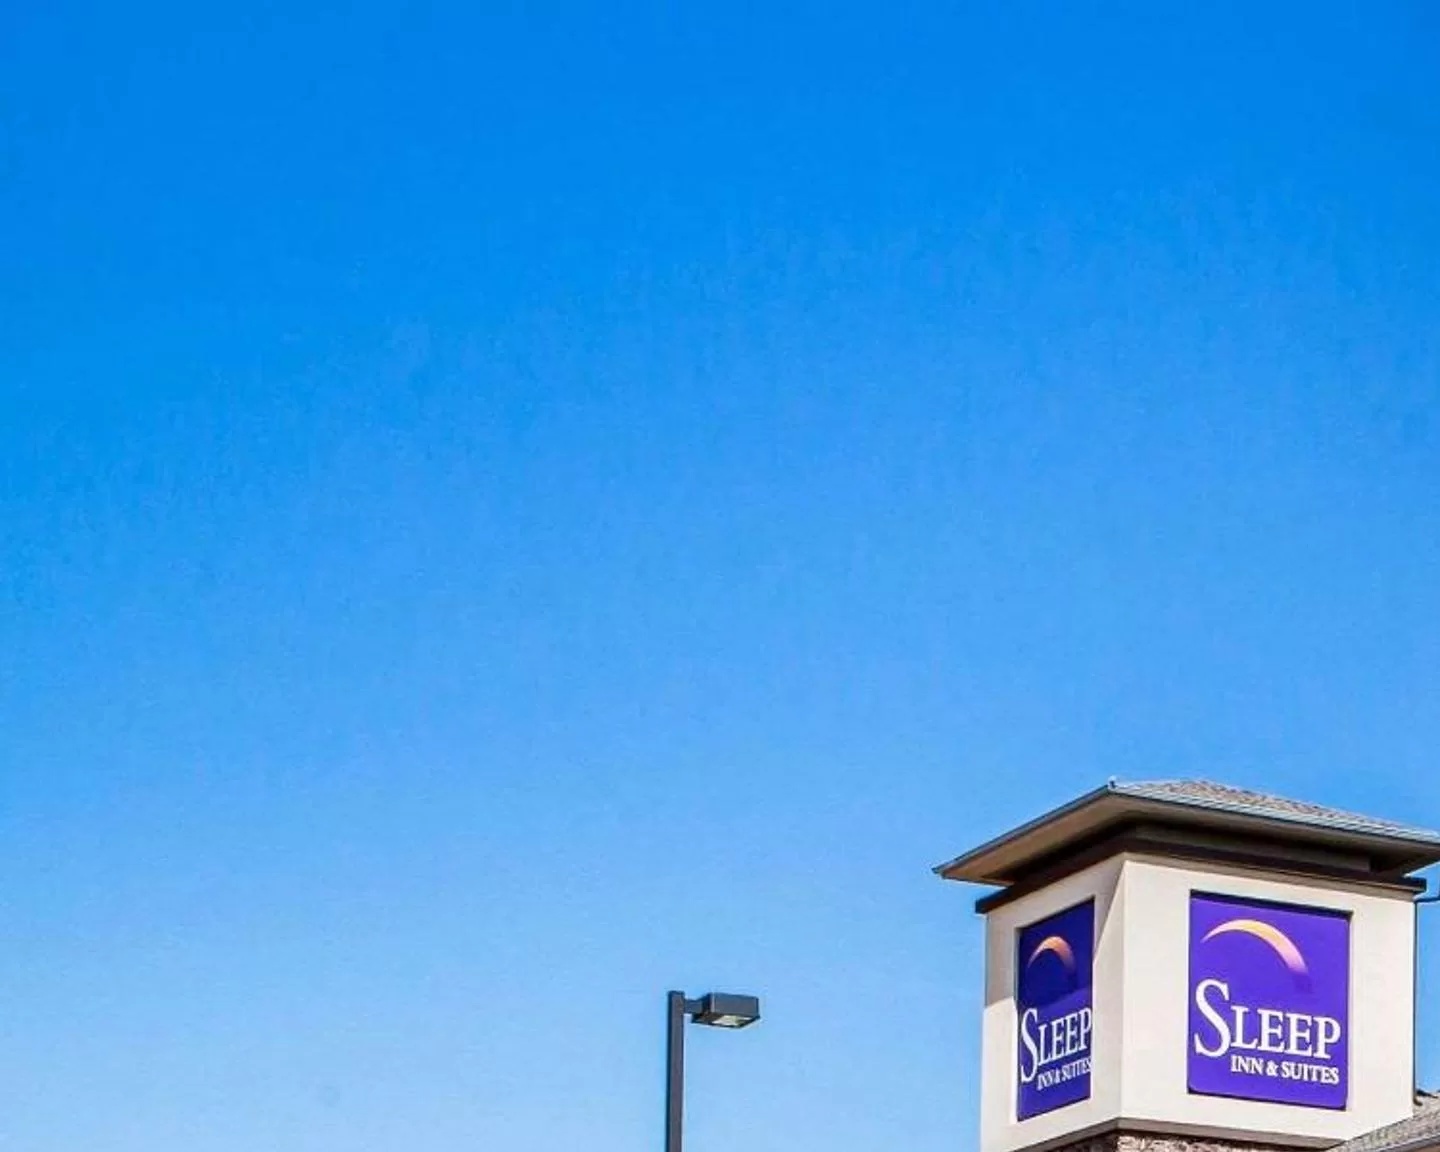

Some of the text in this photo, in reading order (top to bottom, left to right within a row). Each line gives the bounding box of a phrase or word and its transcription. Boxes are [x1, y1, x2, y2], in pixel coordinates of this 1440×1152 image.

[1021, 1008, 1092, 1082] SLEEP
[1194, 979, 1341, 1058] SLEEP
[1230, 1055, 1340, 1084] INN & SUITES
